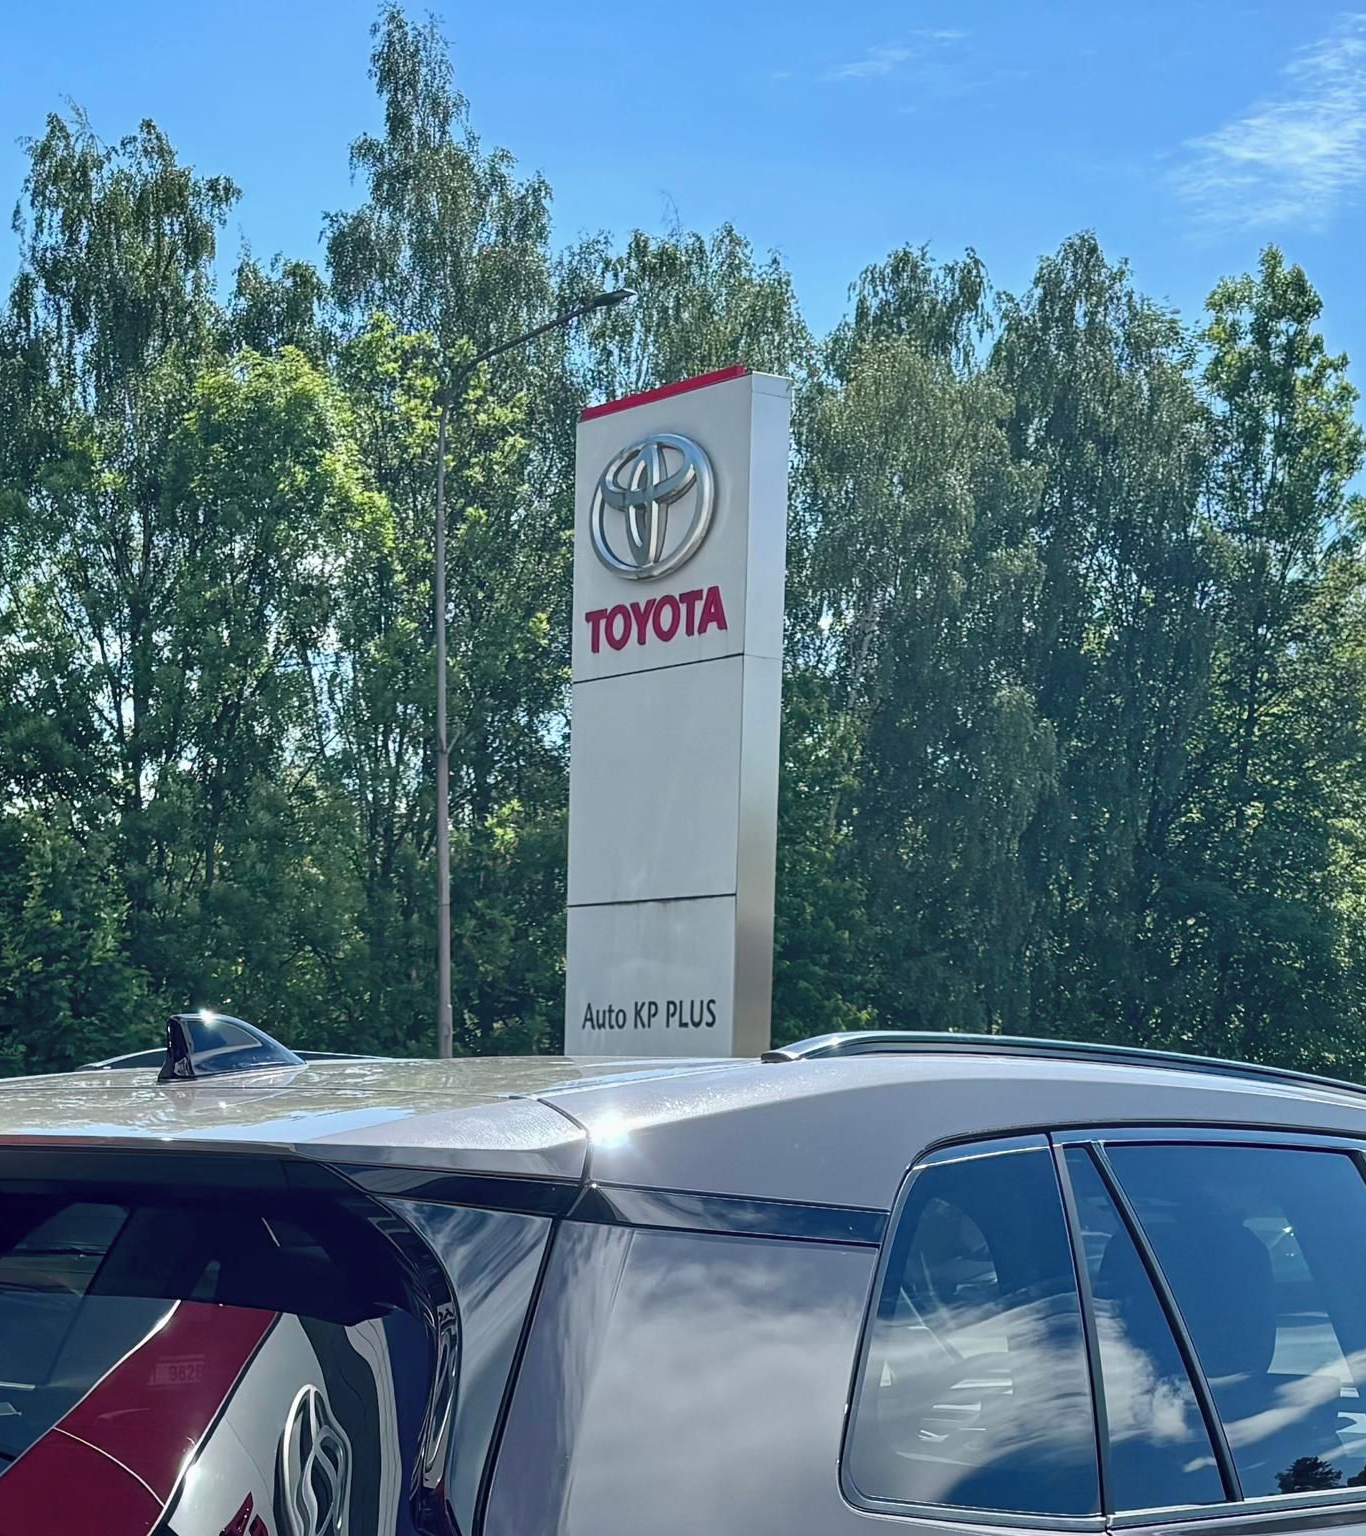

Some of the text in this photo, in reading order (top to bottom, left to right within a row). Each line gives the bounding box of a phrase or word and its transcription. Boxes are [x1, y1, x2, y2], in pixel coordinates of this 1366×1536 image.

[585, 585, 728, 654] TOYOTA
[582, 999, 716, 1031] Auto KP PLUS
